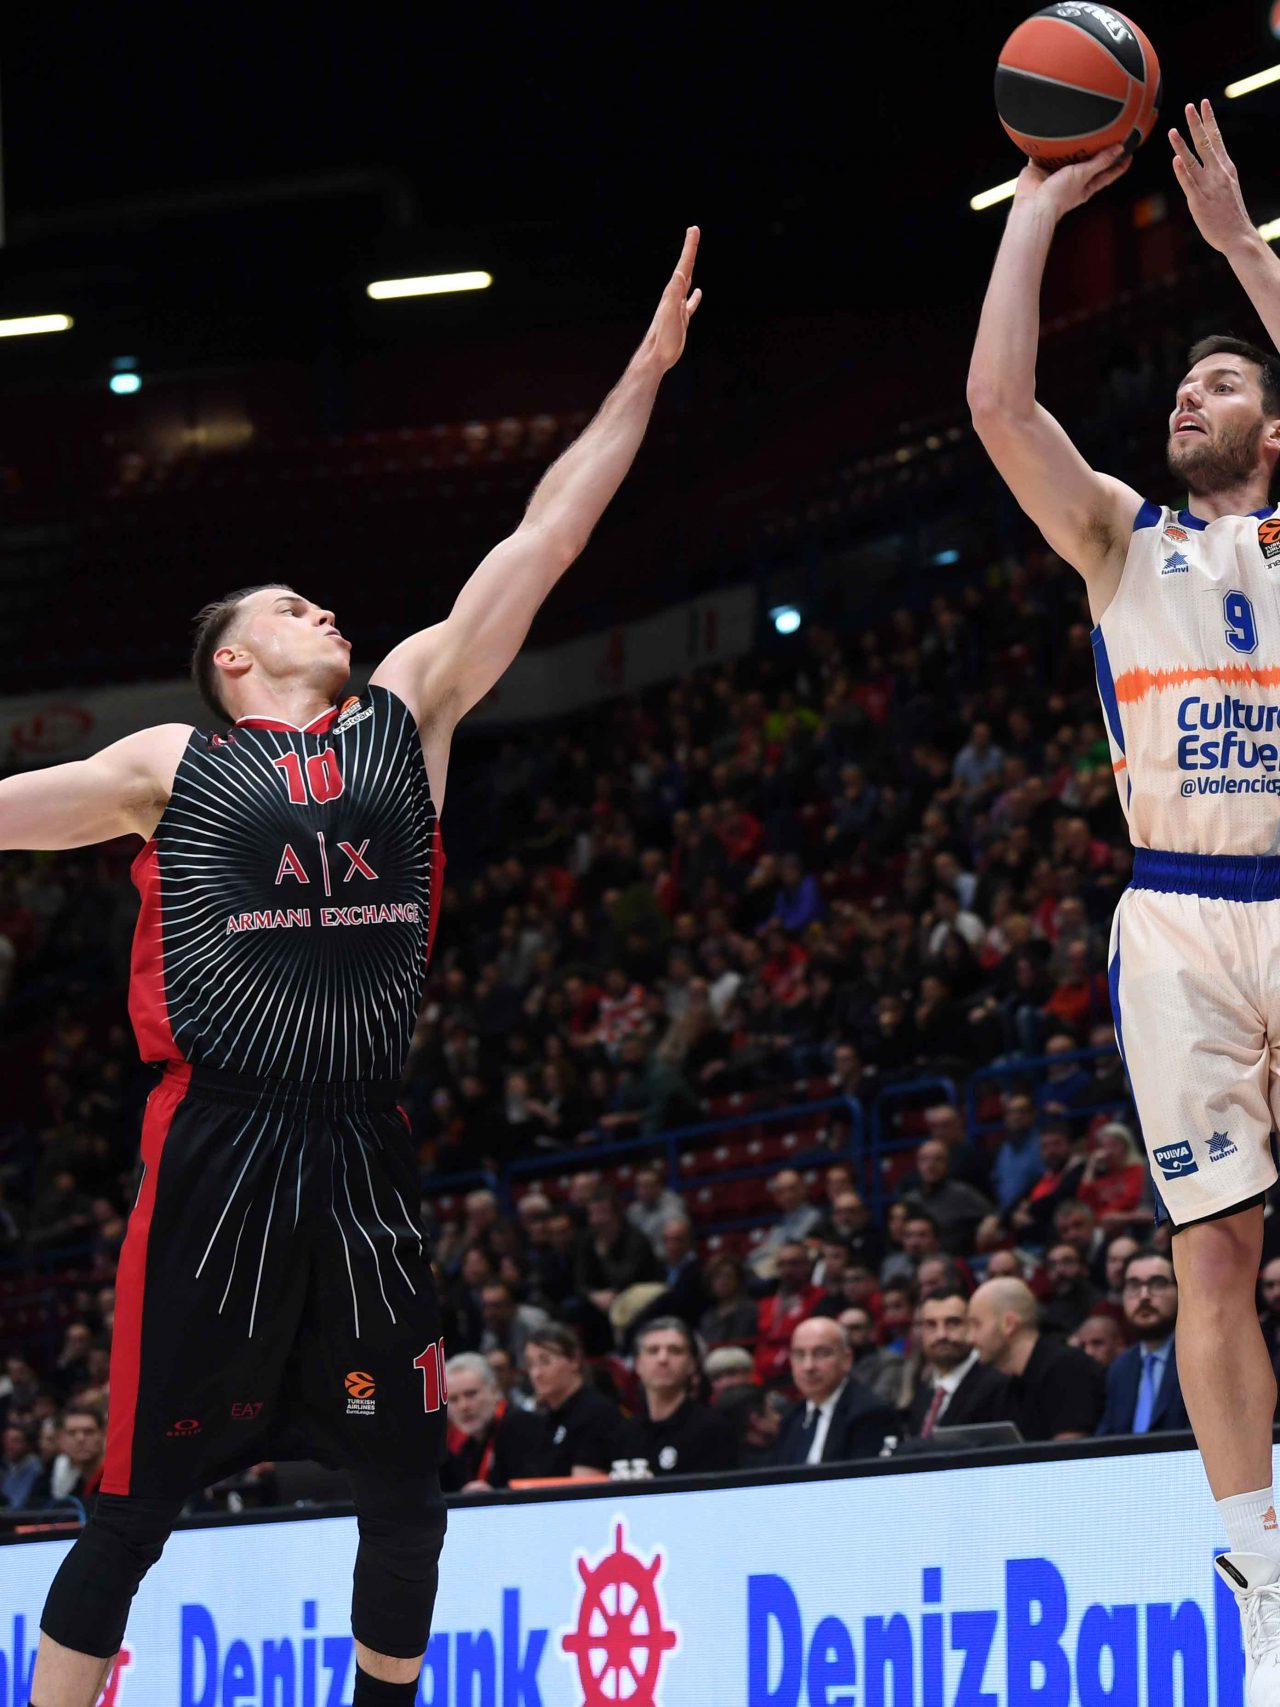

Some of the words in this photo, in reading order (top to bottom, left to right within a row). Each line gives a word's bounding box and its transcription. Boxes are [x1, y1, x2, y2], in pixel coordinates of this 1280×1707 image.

[1223, 589, 1259, 654] 9
[273, 747, 345, 805] 10
[226, 909, 311, 935] ARMANI
[320, 903, 419, 927] EXCHANGE
[1209, 1144, 1238, 1162] luanvi
[231, 1402, 263, 1417] EA7
[347, 1398, 376, 1406] TURKISH
[181, 1586, 548, 1707] Denizank
